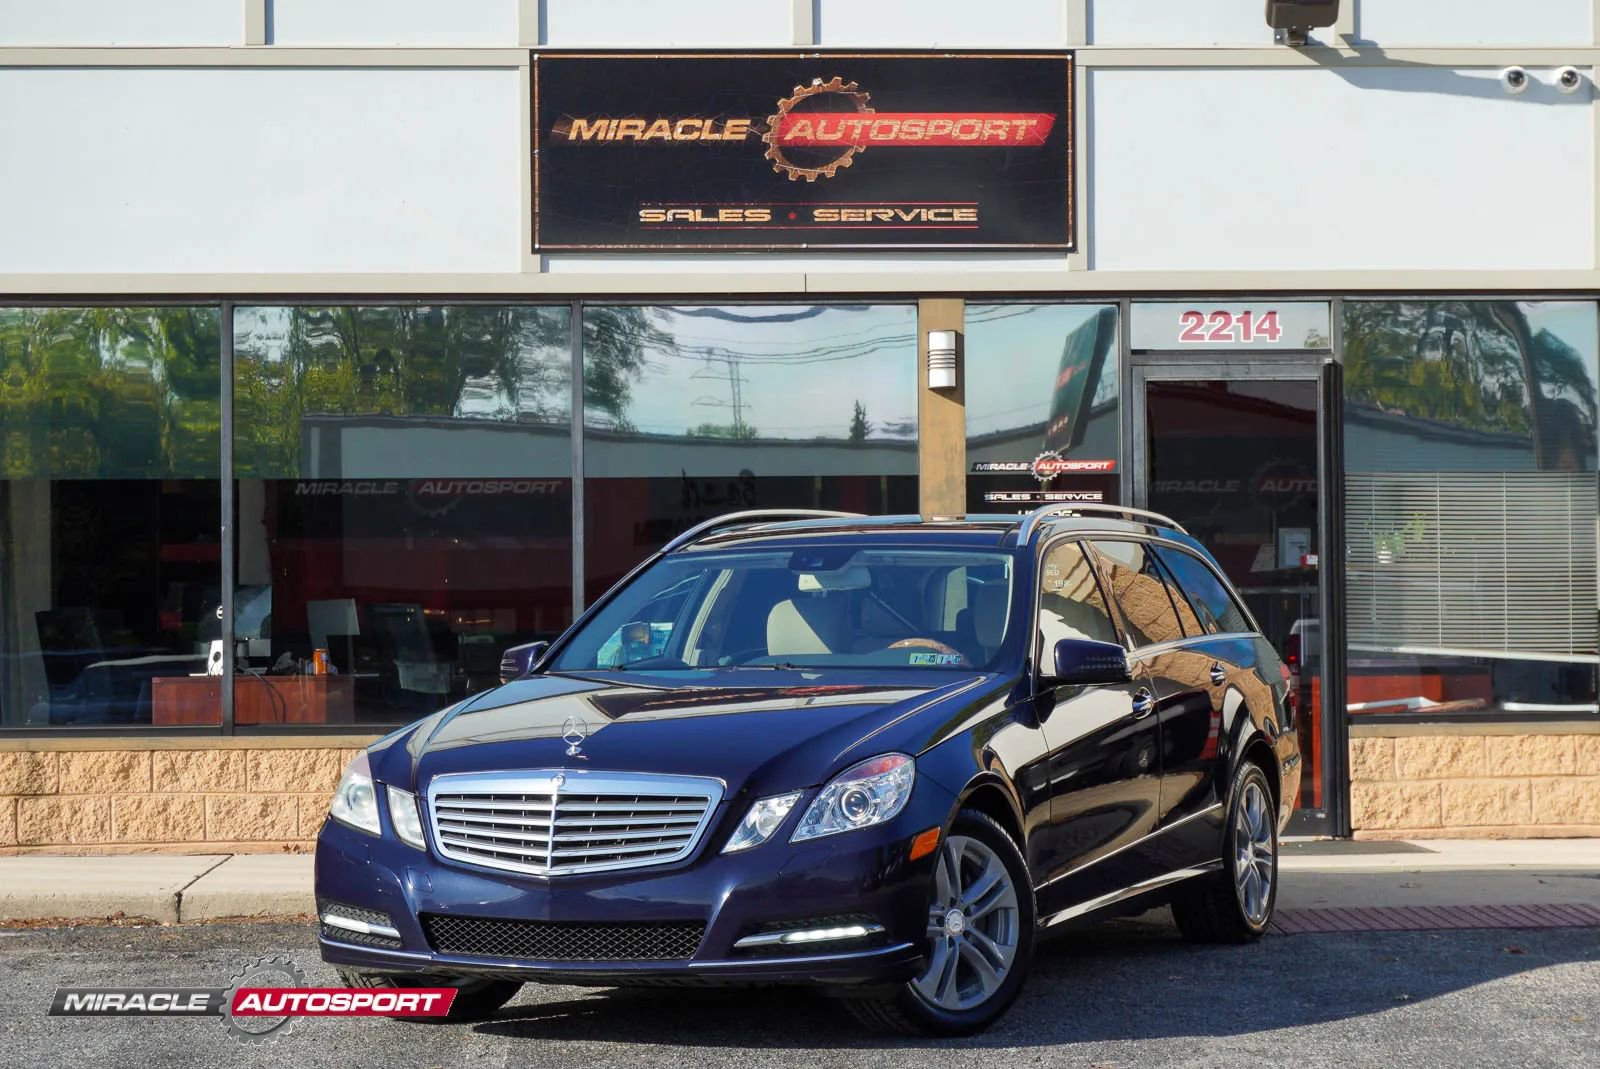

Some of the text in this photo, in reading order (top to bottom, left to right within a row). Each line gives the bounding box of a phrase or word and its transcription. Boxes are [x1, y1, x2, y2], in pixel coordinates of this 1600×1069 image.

[567, 118, 1038, 142] MIRACLE AUTOSPORT
[638, 208, 979, 223] SALES SERVICE
[1179, 310, 1282, 342] 2214
[976, 461, 1110, 471] MIRACLE AUTOSPORT
[294, 480, 562, 495] MIRACLE AUTOSPORT
